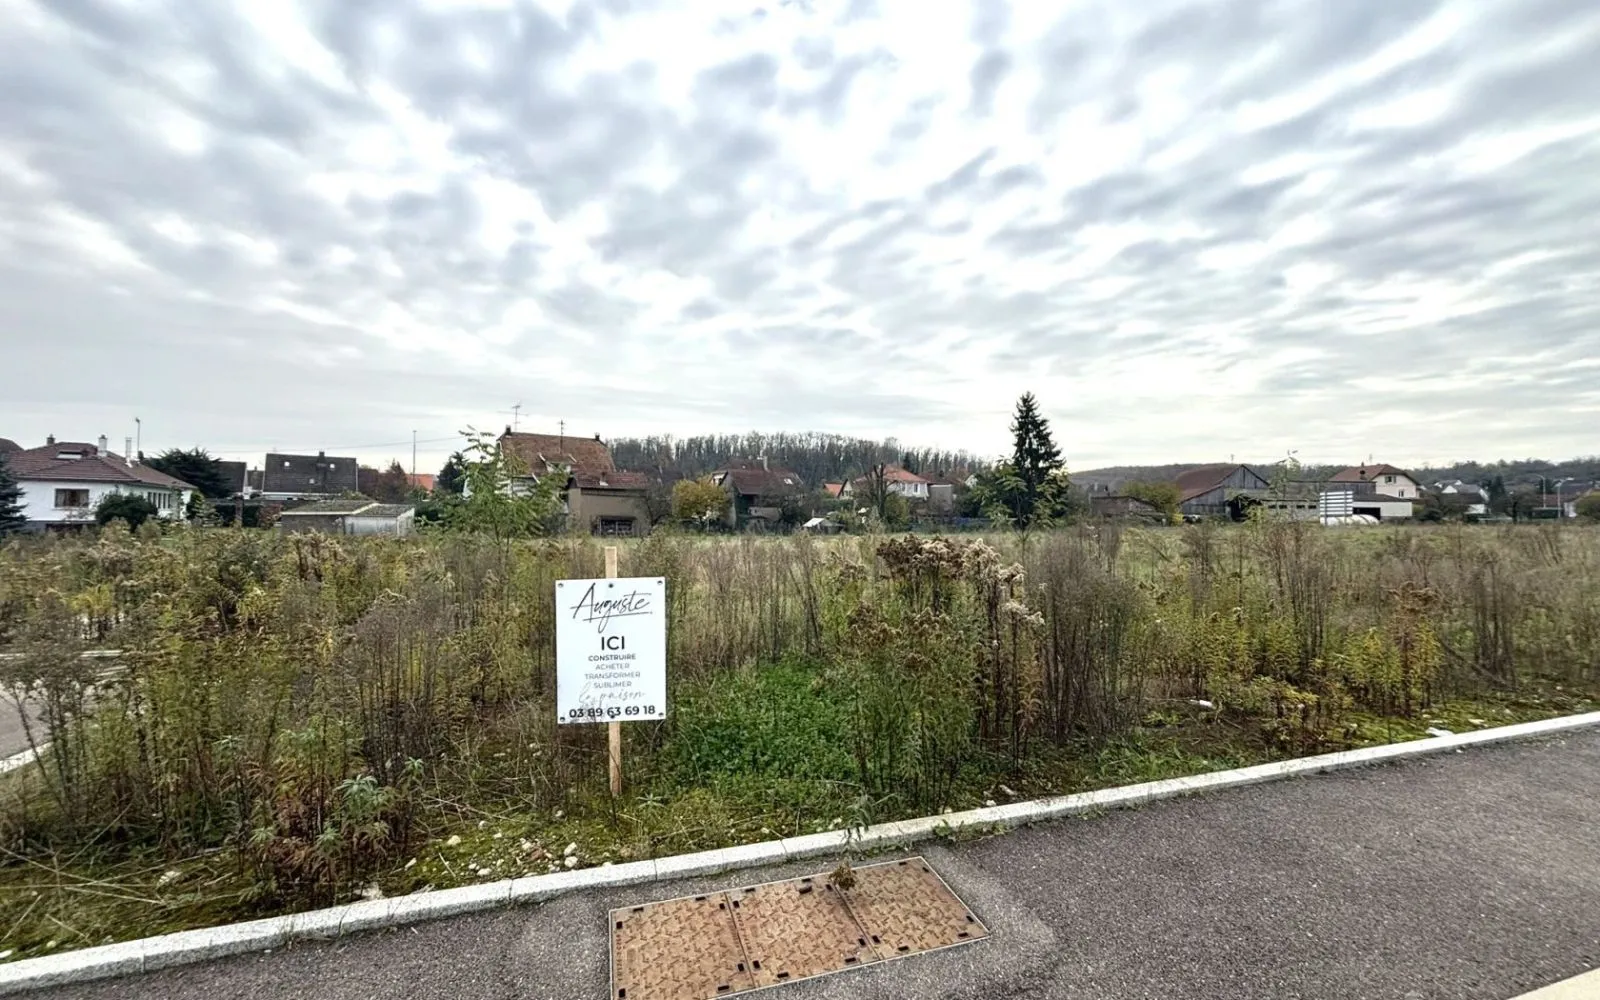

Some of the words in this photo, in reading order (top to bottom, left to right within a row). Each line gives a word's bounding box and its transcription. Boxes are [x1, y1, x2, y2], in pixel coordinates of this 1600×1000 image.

[569, 582, 652, 634] Auguste
[601, 635, 625, 651] ICI
[588, 653, 636, 662] CONSTRUIRE
[595, 662, 630, 670] ACHETER
[584, 671, 641, 680] TRANSFORMER
[593, 680, 632, 689] SUBLIMER
[569, 708, 585, 718] 03
[587, 707, 603, 717] 89
[607, 706, 621, 717] 63
[625, 705, 640, 716] 69
[643, 704, 656, 715] 18
